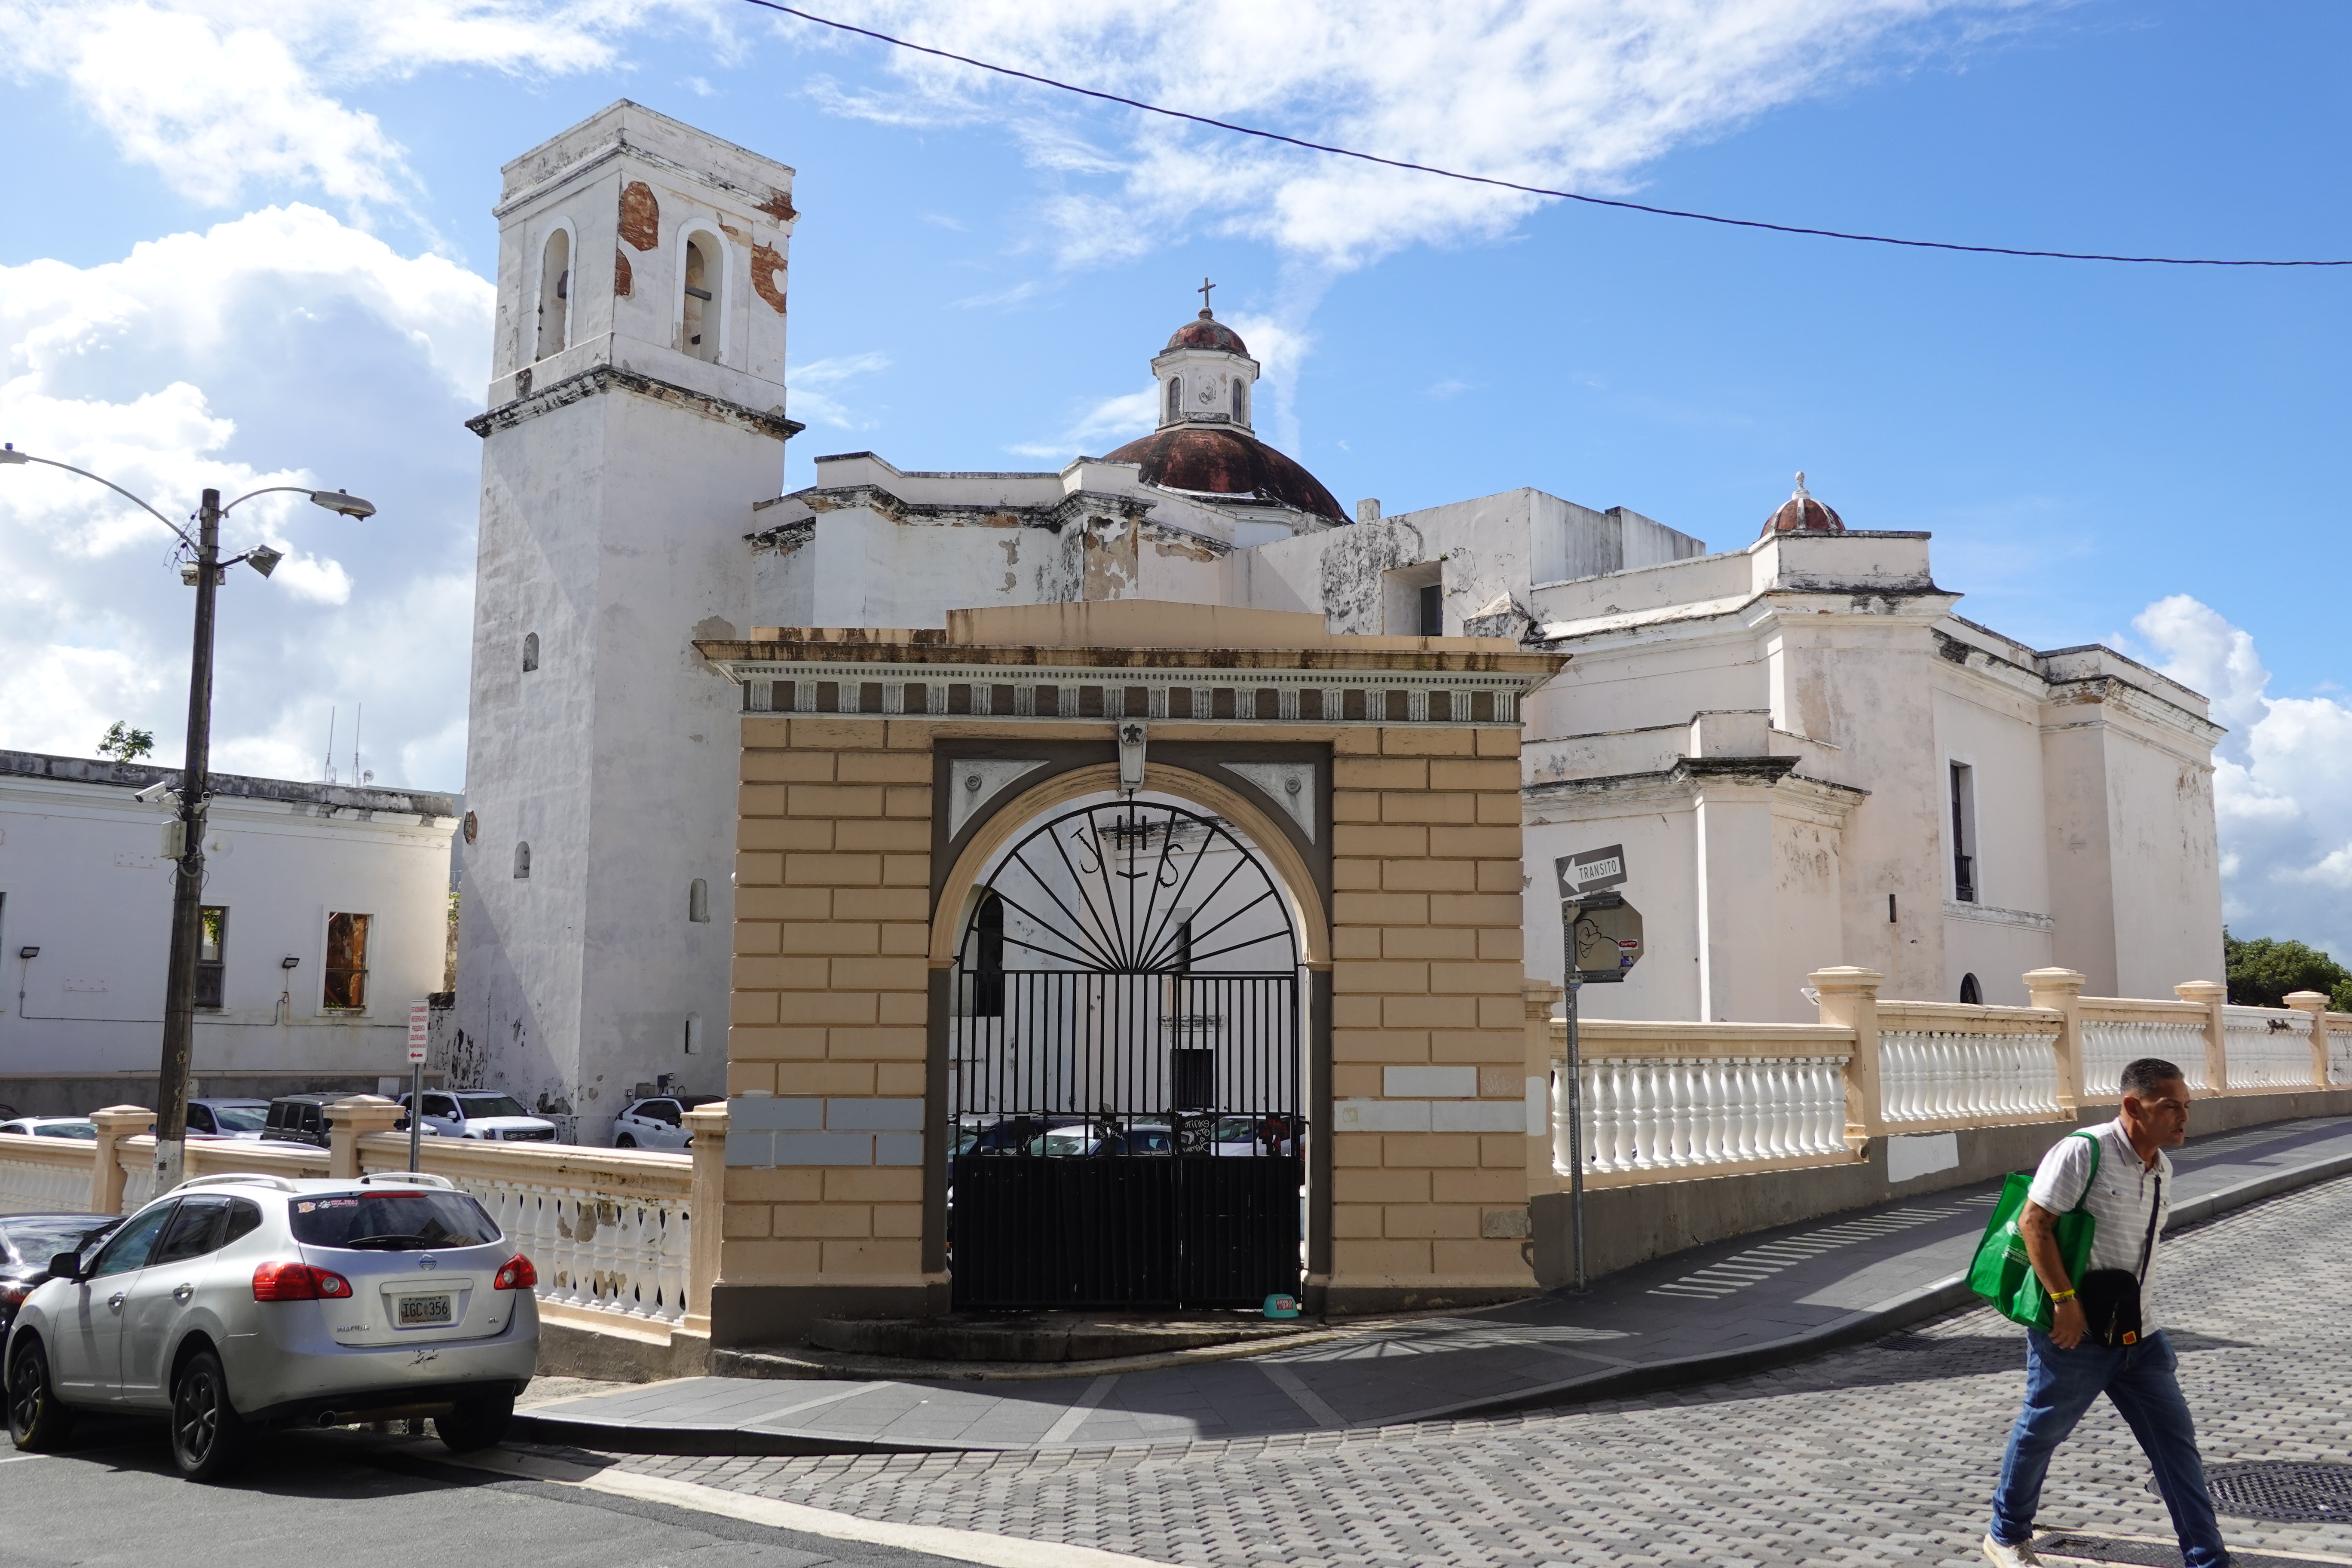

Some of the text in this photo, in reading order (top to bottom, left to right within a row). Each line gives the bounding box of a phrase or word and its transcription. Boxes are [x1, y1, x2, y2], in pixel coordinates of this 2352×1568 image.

[1579, 860, 1617, 880] TRANSITO
[403, 1302, 448, 1317] IGC 356
